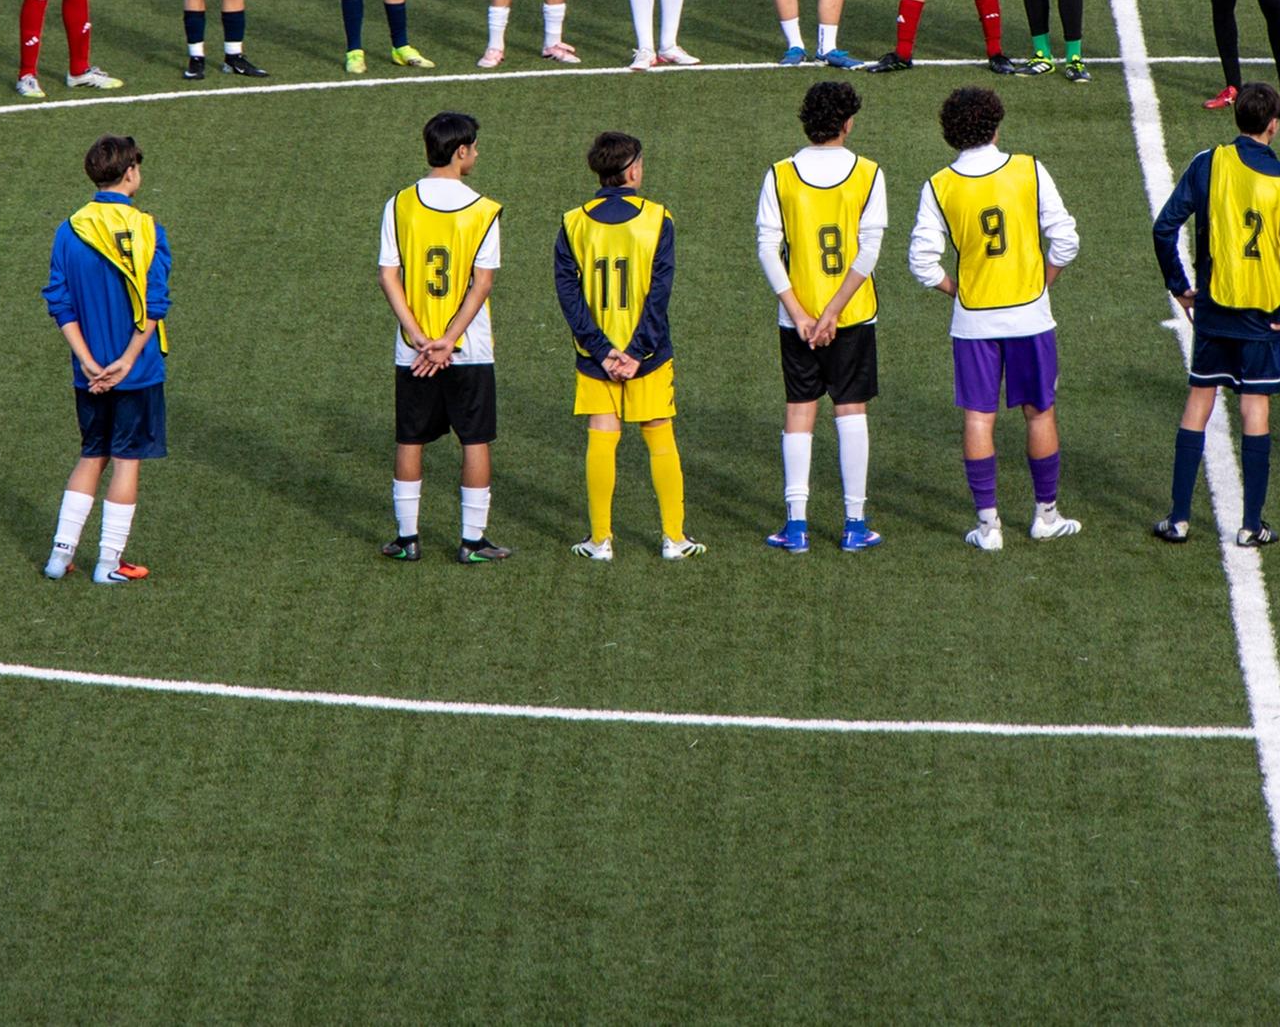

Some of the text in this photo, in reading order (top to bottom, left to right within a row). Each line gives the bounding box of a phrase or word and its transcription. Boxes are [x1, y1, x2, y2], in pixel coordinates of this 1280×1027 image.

[819, 225, 845, 277] 8
[978, 205, 1008, 258] 9
[1243, 208, 1264, 260] 2
[425, 246, 450, 299] 3
[594, 257, 630, 310] 11
